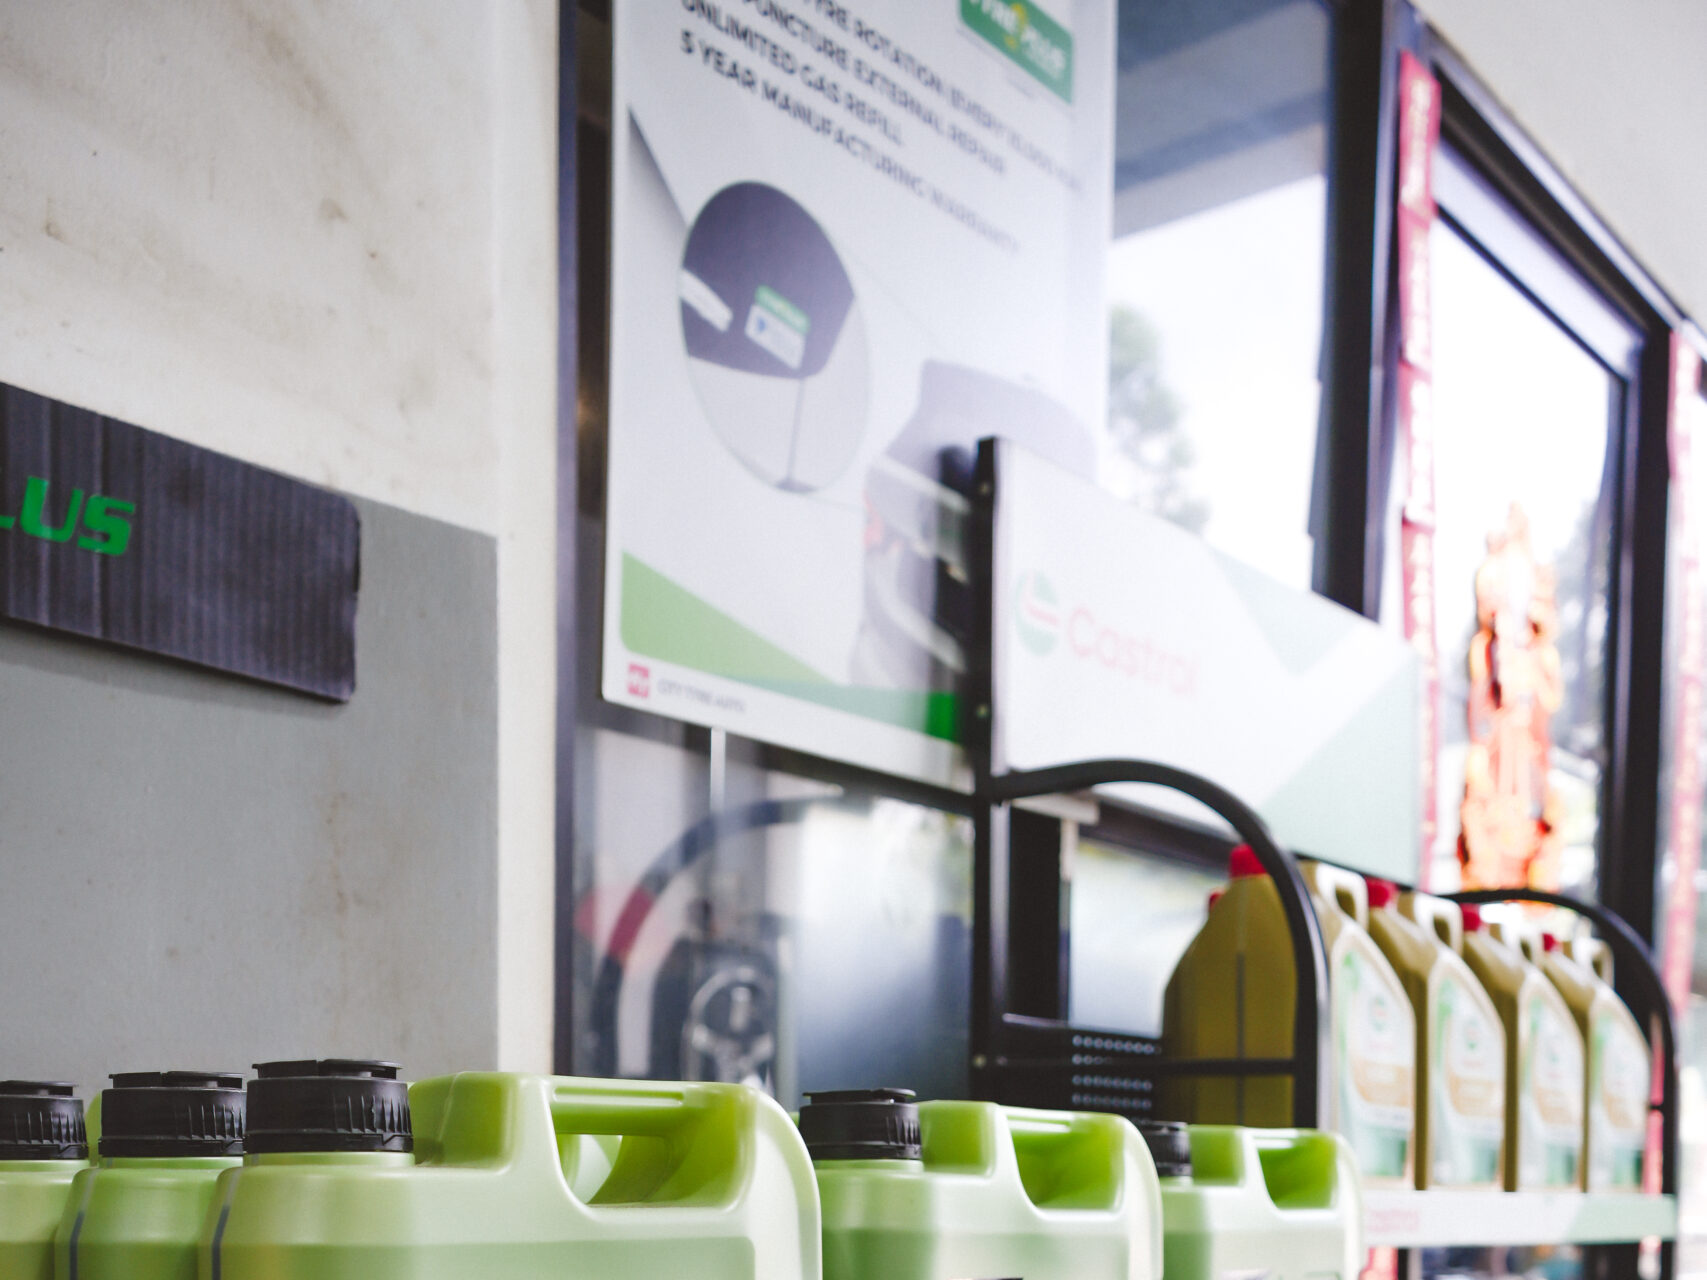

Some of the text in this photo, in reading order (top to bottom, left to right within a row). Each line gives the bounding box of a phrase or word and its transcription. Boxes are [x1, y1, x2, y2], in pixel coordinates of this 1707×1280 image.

[680, 29, 695, 55] 5
[698, 38, 758, 94] YEAR
[761, 79, 924, 196] MANUFACTURING
[744, 0, 850, 72] UNCTURE
[853, 58, 945, 137] EXTERNAL
[800, 63, 841, 104] GAS
[844, 91, 903, 146] REFILL
